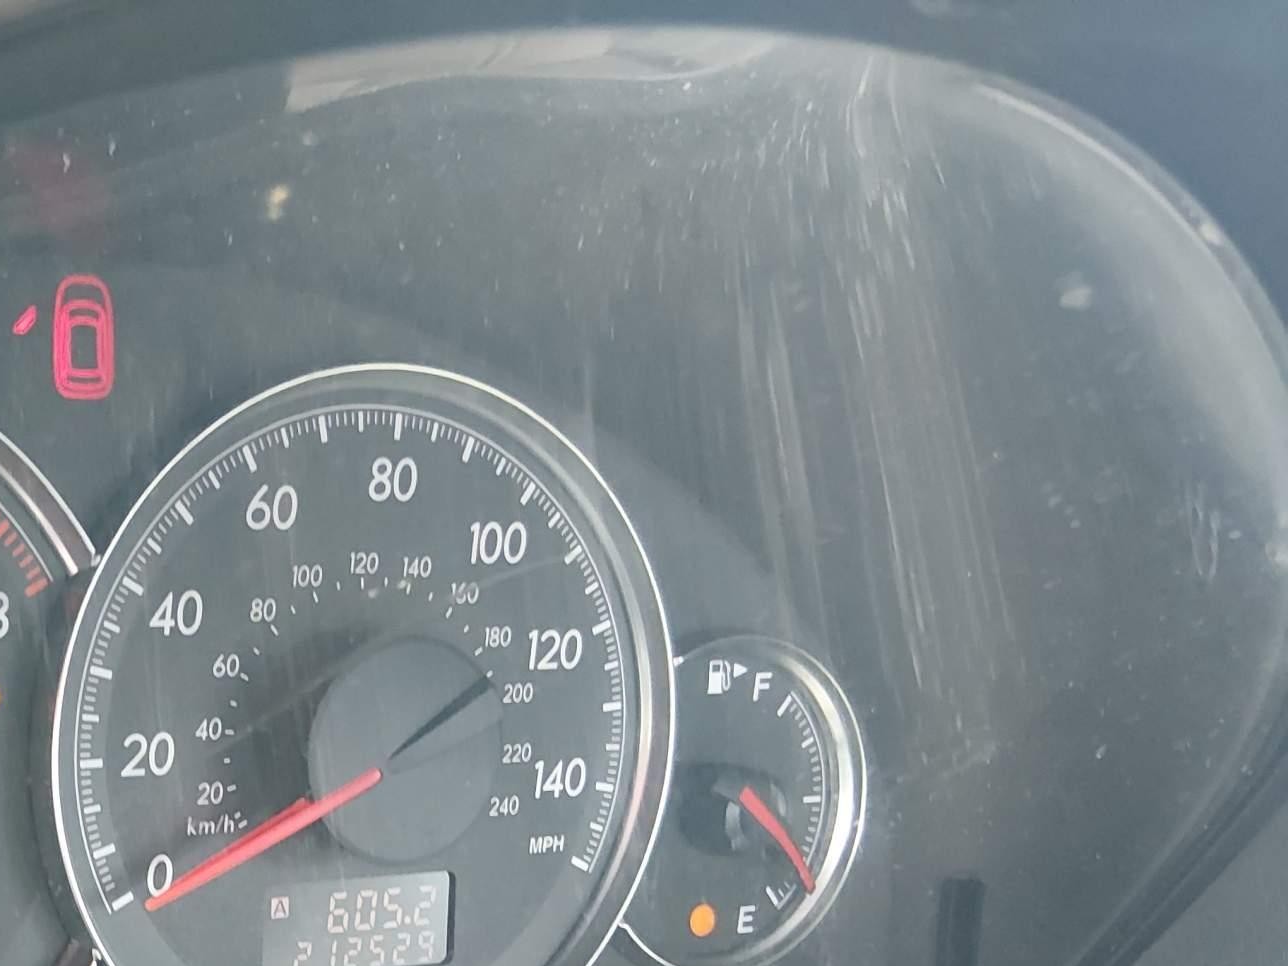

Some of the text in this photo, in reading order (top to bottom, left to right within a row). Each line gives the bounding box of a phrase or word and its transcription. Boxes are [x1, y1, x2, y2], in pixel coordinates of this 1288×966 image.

[368, 456, 418, 503] 80
[245, 484, 298, 531] 60
[470, 521, 527, 565] 100
[350, 552, 379, 575] 120
[403, 556, 432, 578] 140
[292, 565, 323, 588] 100
[150, 590, 203, 637] 40
[250, 598, 276, 623] 80
[484, 626, 512, 648] 180
[528, 629, 583, 671] 120
[212, 653, 240, 678] 60
[502, 683, 534, 704] 200
[753, 672, 772, 701] F
[195, 717, 223, 741] 40
[120, 732, 175, 778] 20
[502, 742, 532, 764] 220
[534, 757, 586, 799] 140
[197, 781, 224, 806] 20
[488, 795, 520, 817] 240
[187, 817, 235, 837] km/h
[528, 834, 565, 855] MPH
[146, 853, 174, 898] 0
[328, 885, 436, 933] 605.2
[737, 904, 756, 934] E
